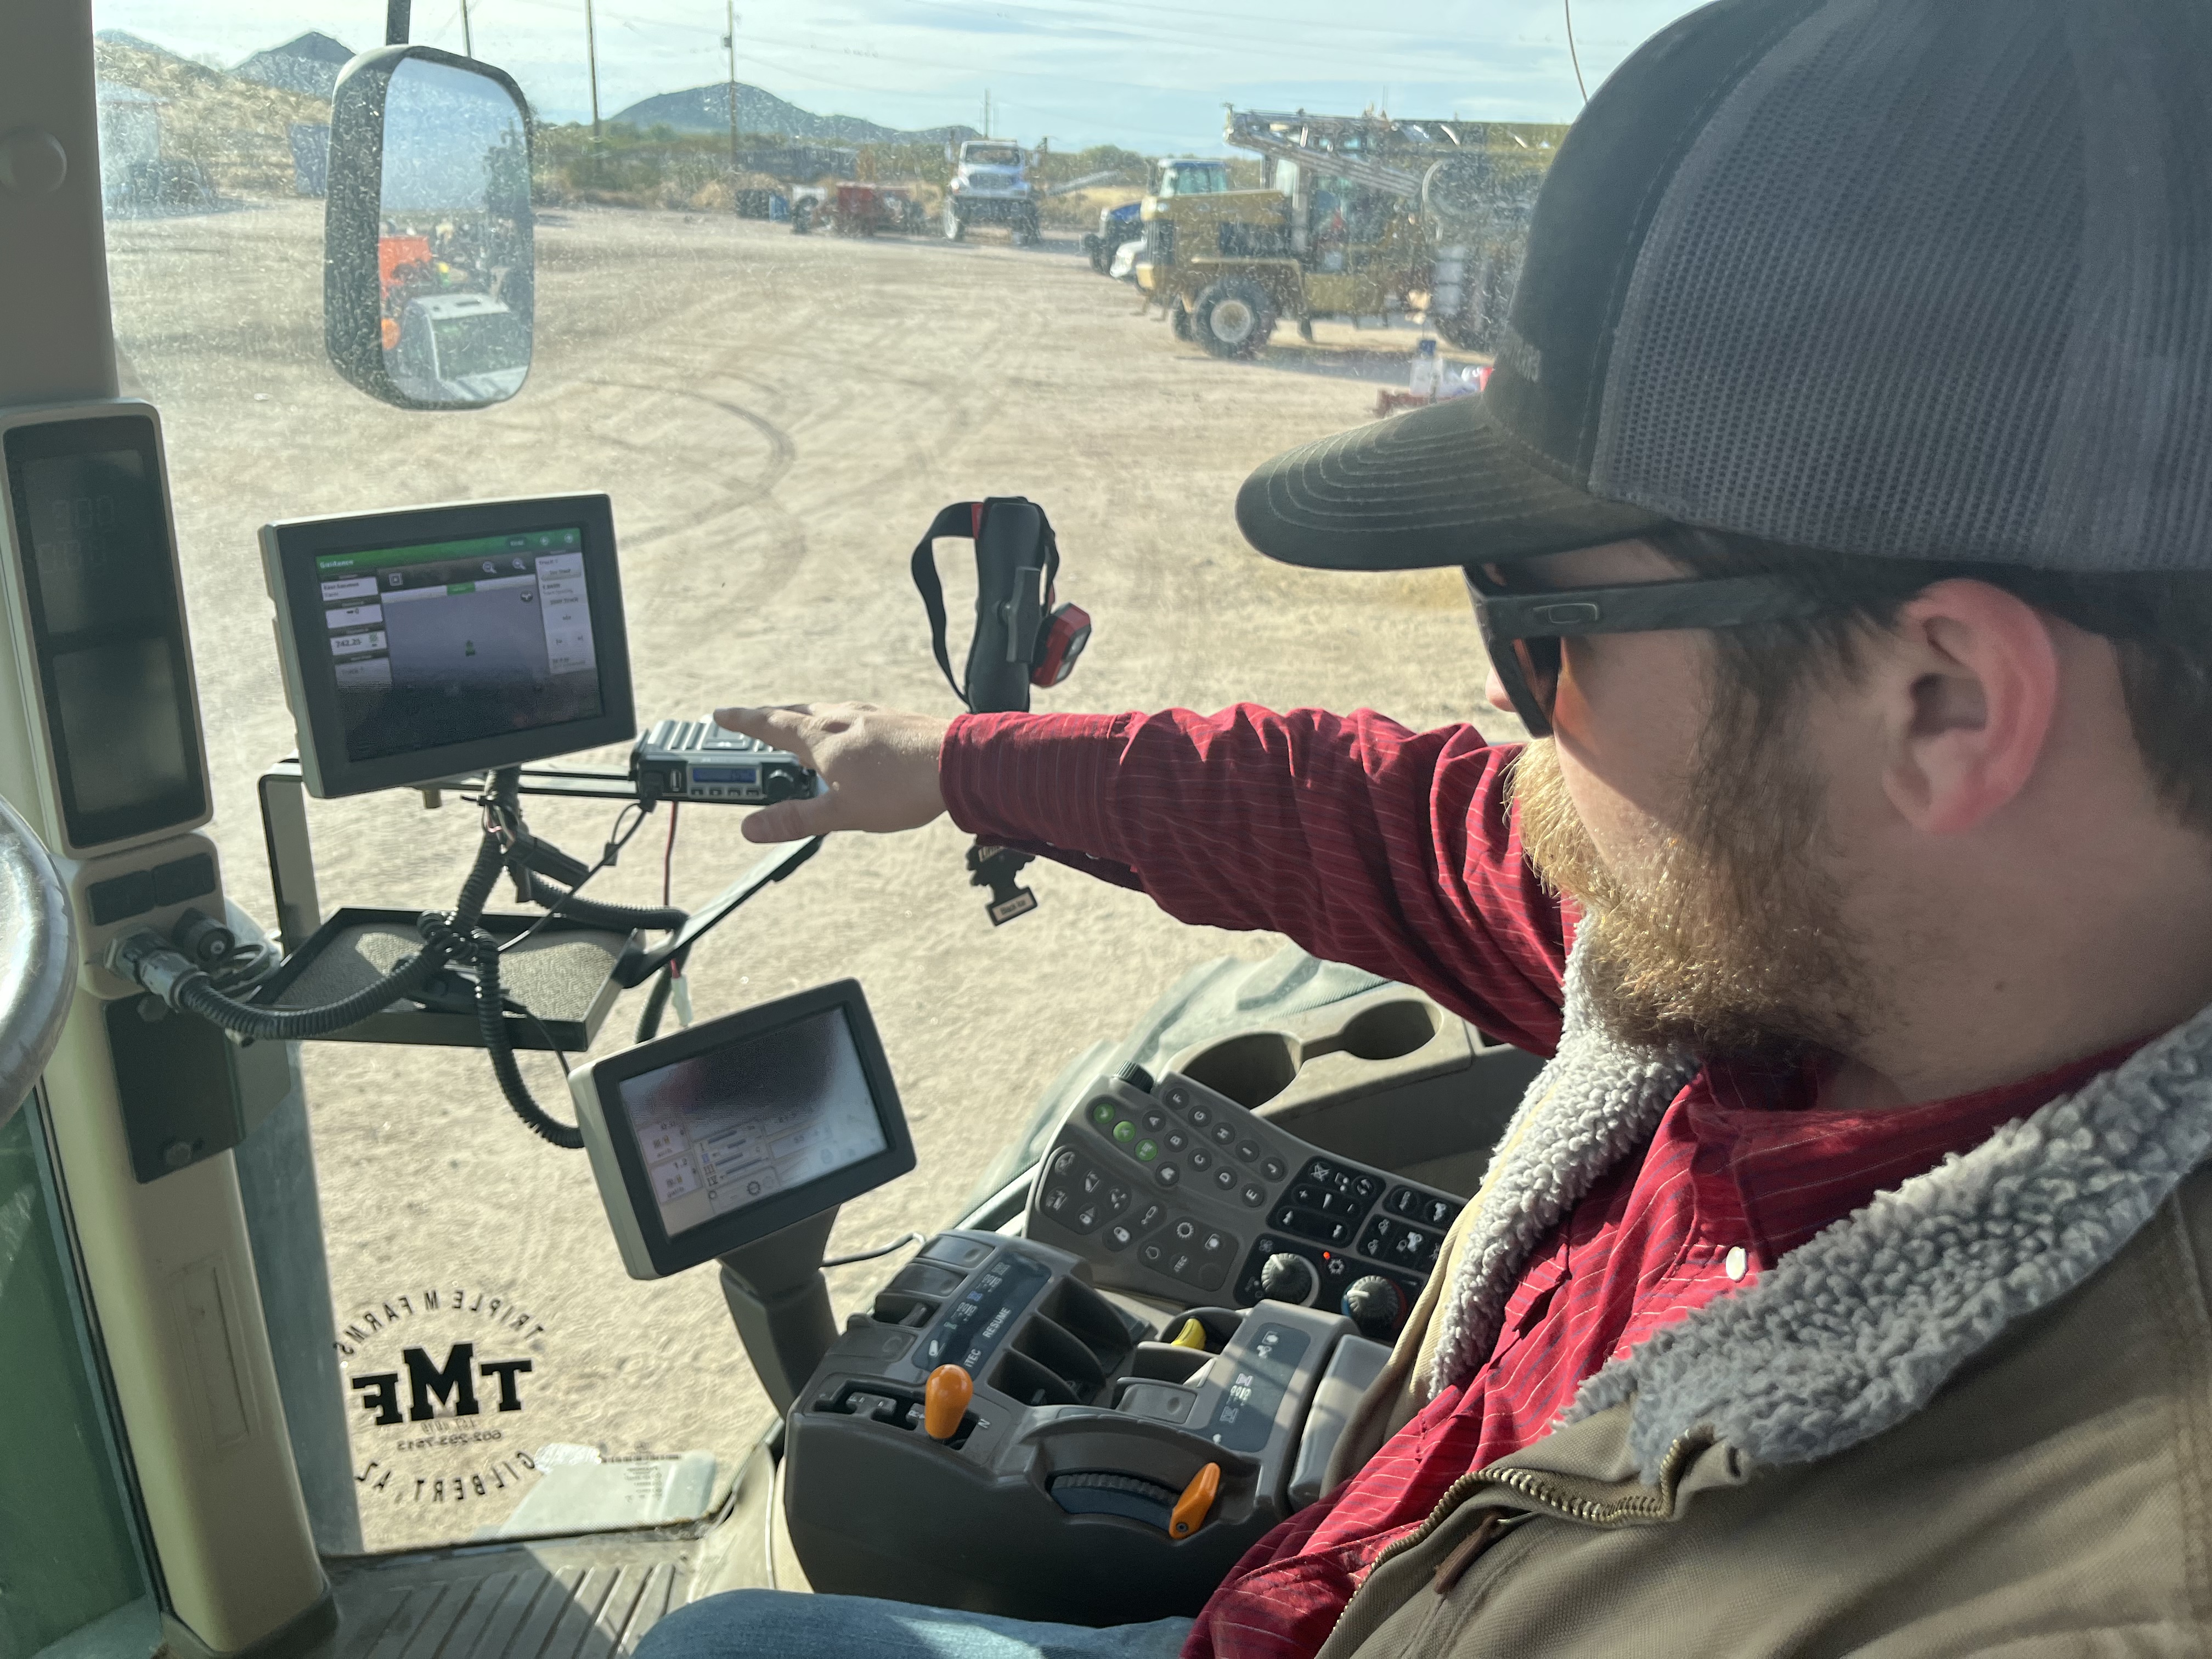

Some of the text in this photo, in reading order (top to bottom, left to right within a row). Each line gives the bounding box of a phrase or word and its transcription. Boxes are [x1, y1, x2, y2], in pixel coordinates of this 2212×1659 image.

[1172, 1093, 1182, 1104] F
[1149, 1115, 1160, 1127] A
[1194, 1110, 1205, 1121] G
[1217, 1127, 1230, 1139] H
[1170, 1135, 1182, 1146] B
[1194, 1154, 1205, 1165] C
[1218, 1172, 1231, 1183] D
[1245, 1188, 1257, 1201] E
[982, 1306, 1012, 1338] RESUME
